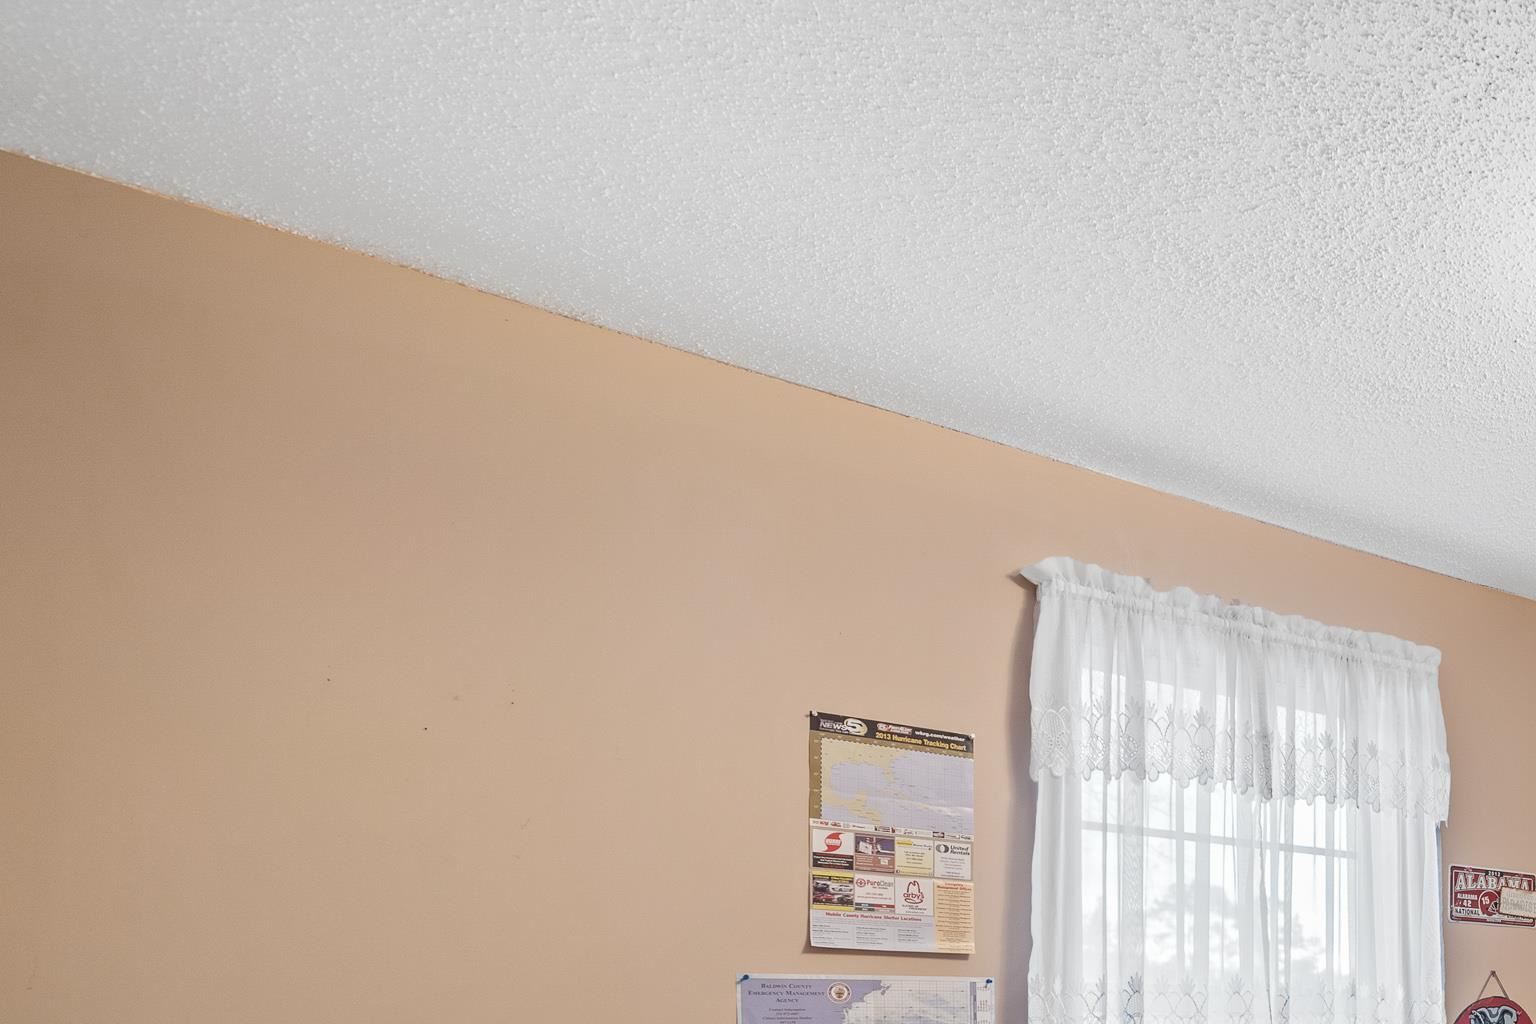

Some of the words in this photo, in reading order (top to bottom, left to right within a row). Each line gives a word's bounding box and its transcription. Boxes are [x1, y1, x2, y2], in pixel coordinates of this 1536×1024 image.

[876, 732, 891, 740] 2013
[892, 735, 922, 744] Hurricane
[924, 738, 949, 750] Tracking
[950, 743, 967, 751] Chart
[1456, 873, 1529, 890] ALABAMA
[1482, 896, 1489, 904] 15
